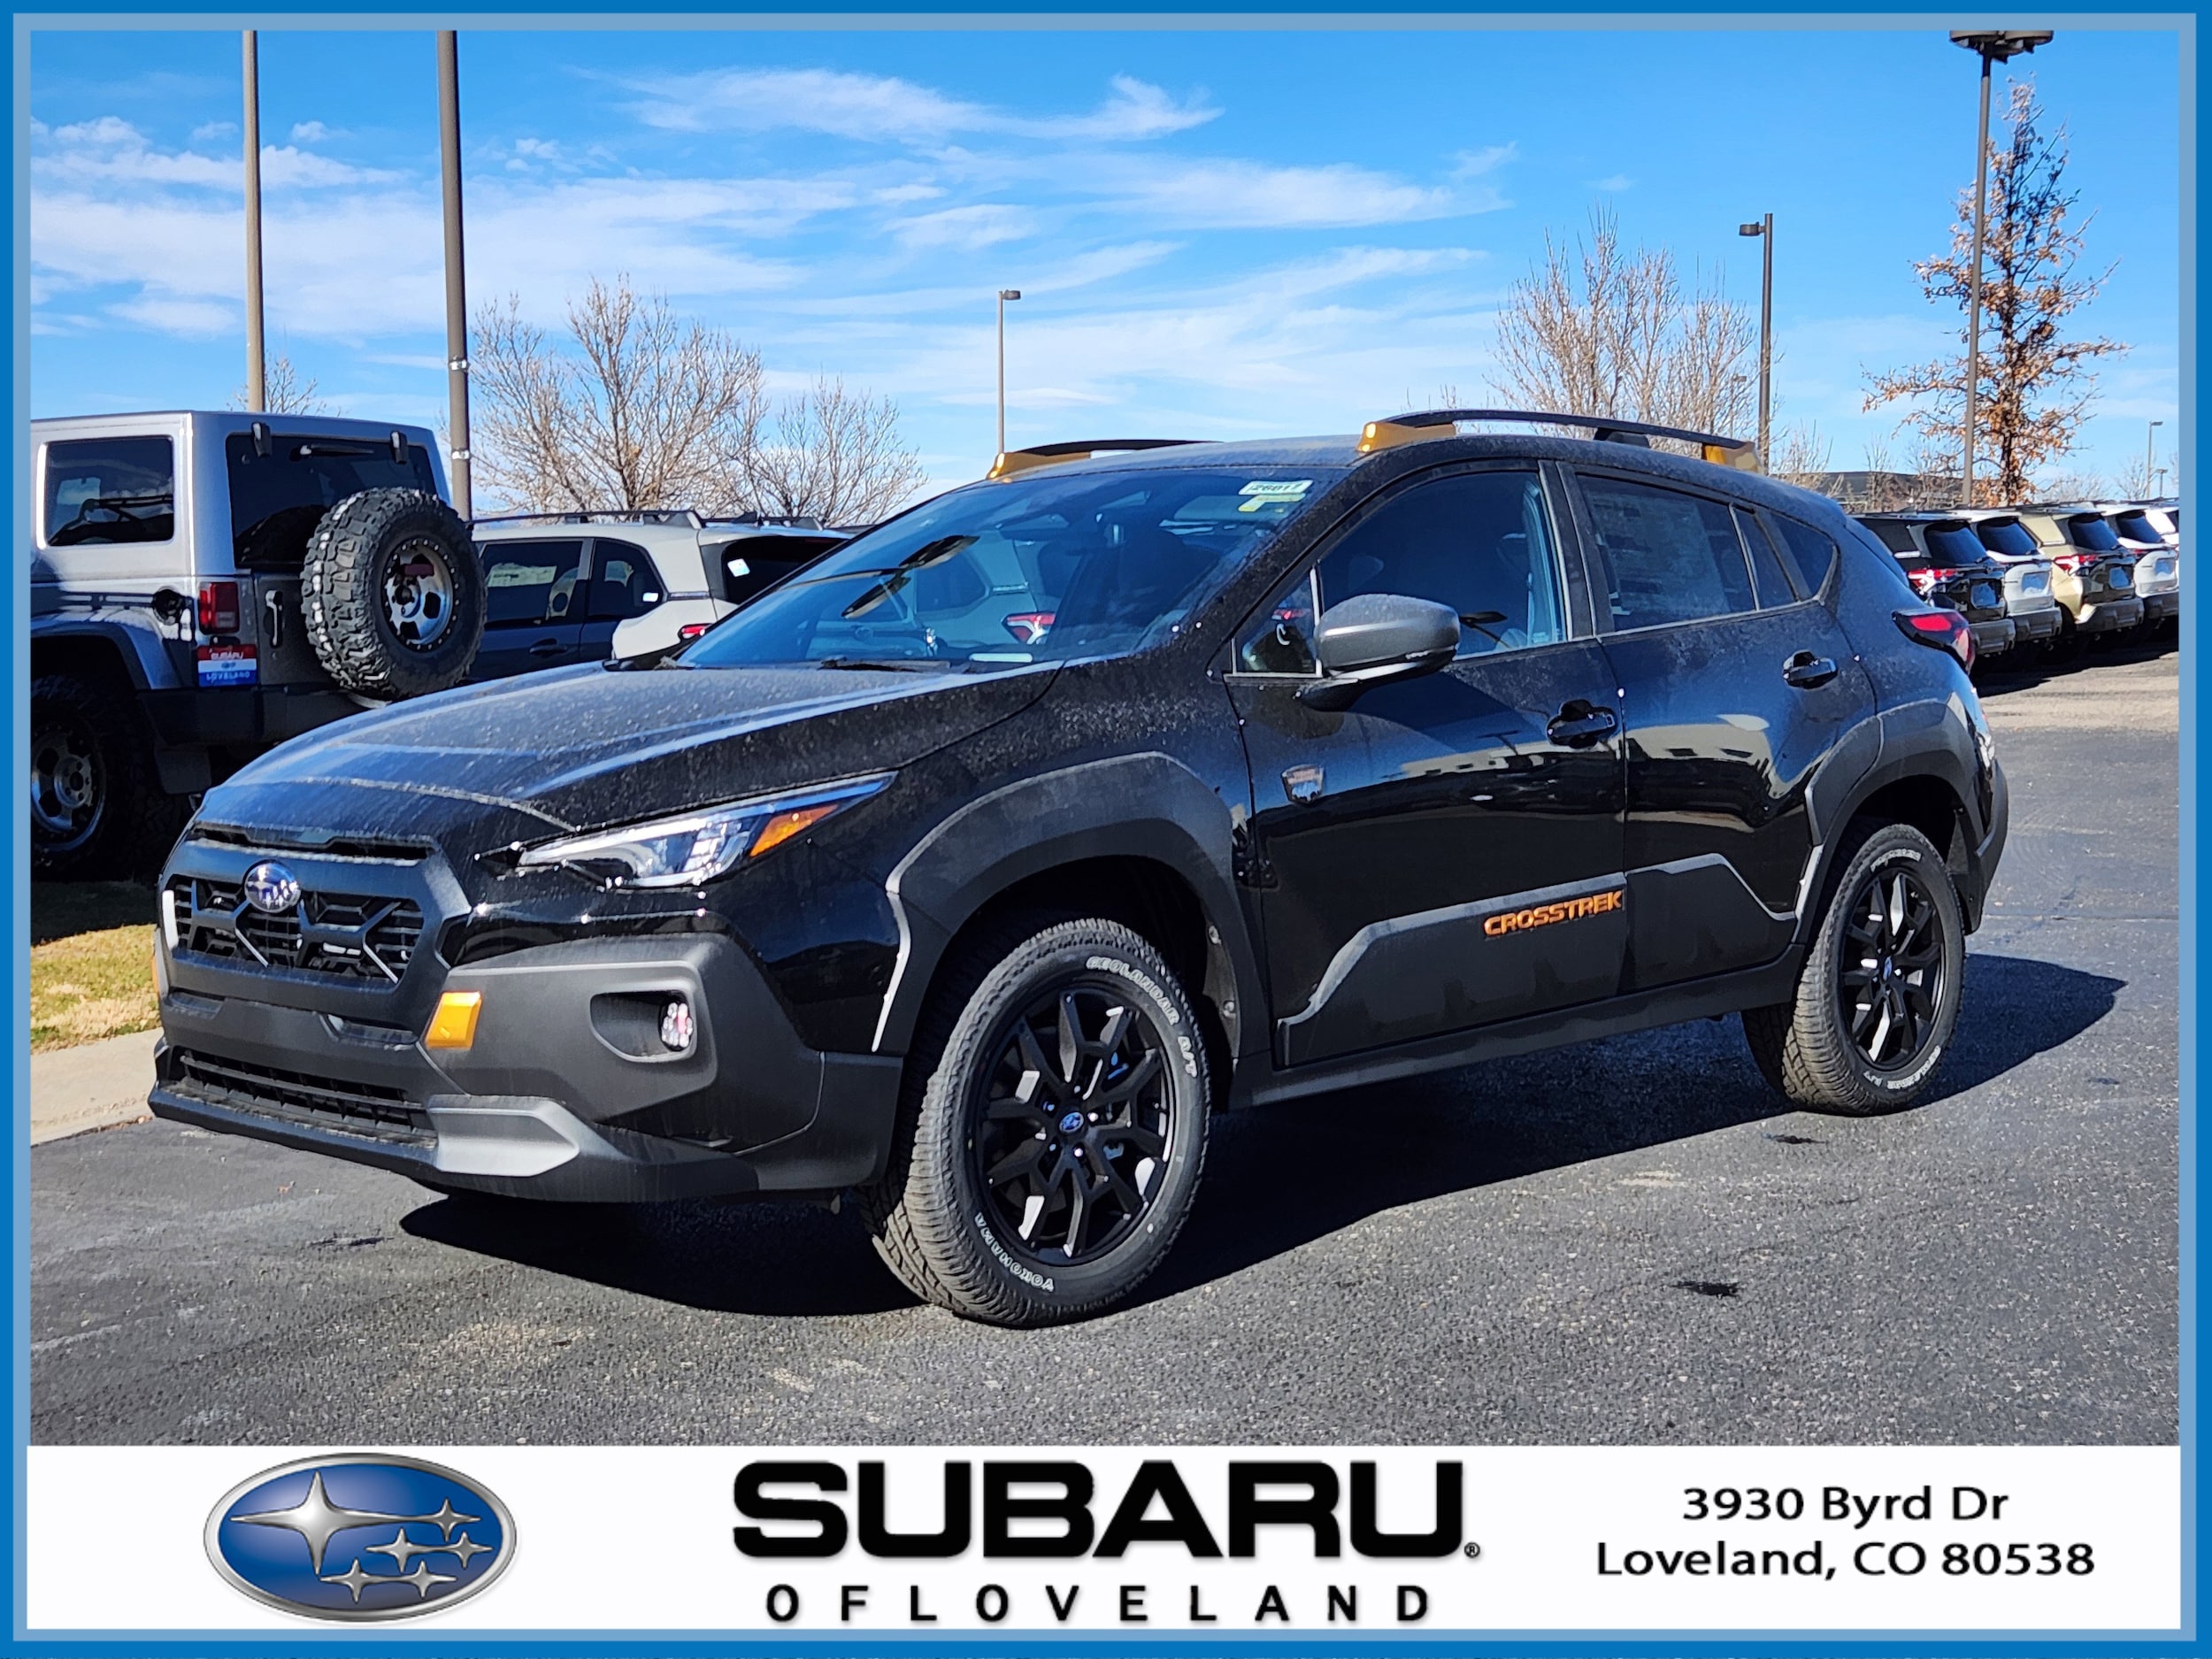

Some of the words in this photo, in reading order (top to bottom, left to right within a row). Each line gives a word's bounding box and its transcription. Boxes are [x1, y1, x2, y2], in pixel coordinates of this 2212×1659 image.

[1484, 890, 1623, 935] CROSSTREK
[1086, 956, 1180, 1025] GEOLANDAR
[974, 1212, 1054, 1292] YOKOHAMA
